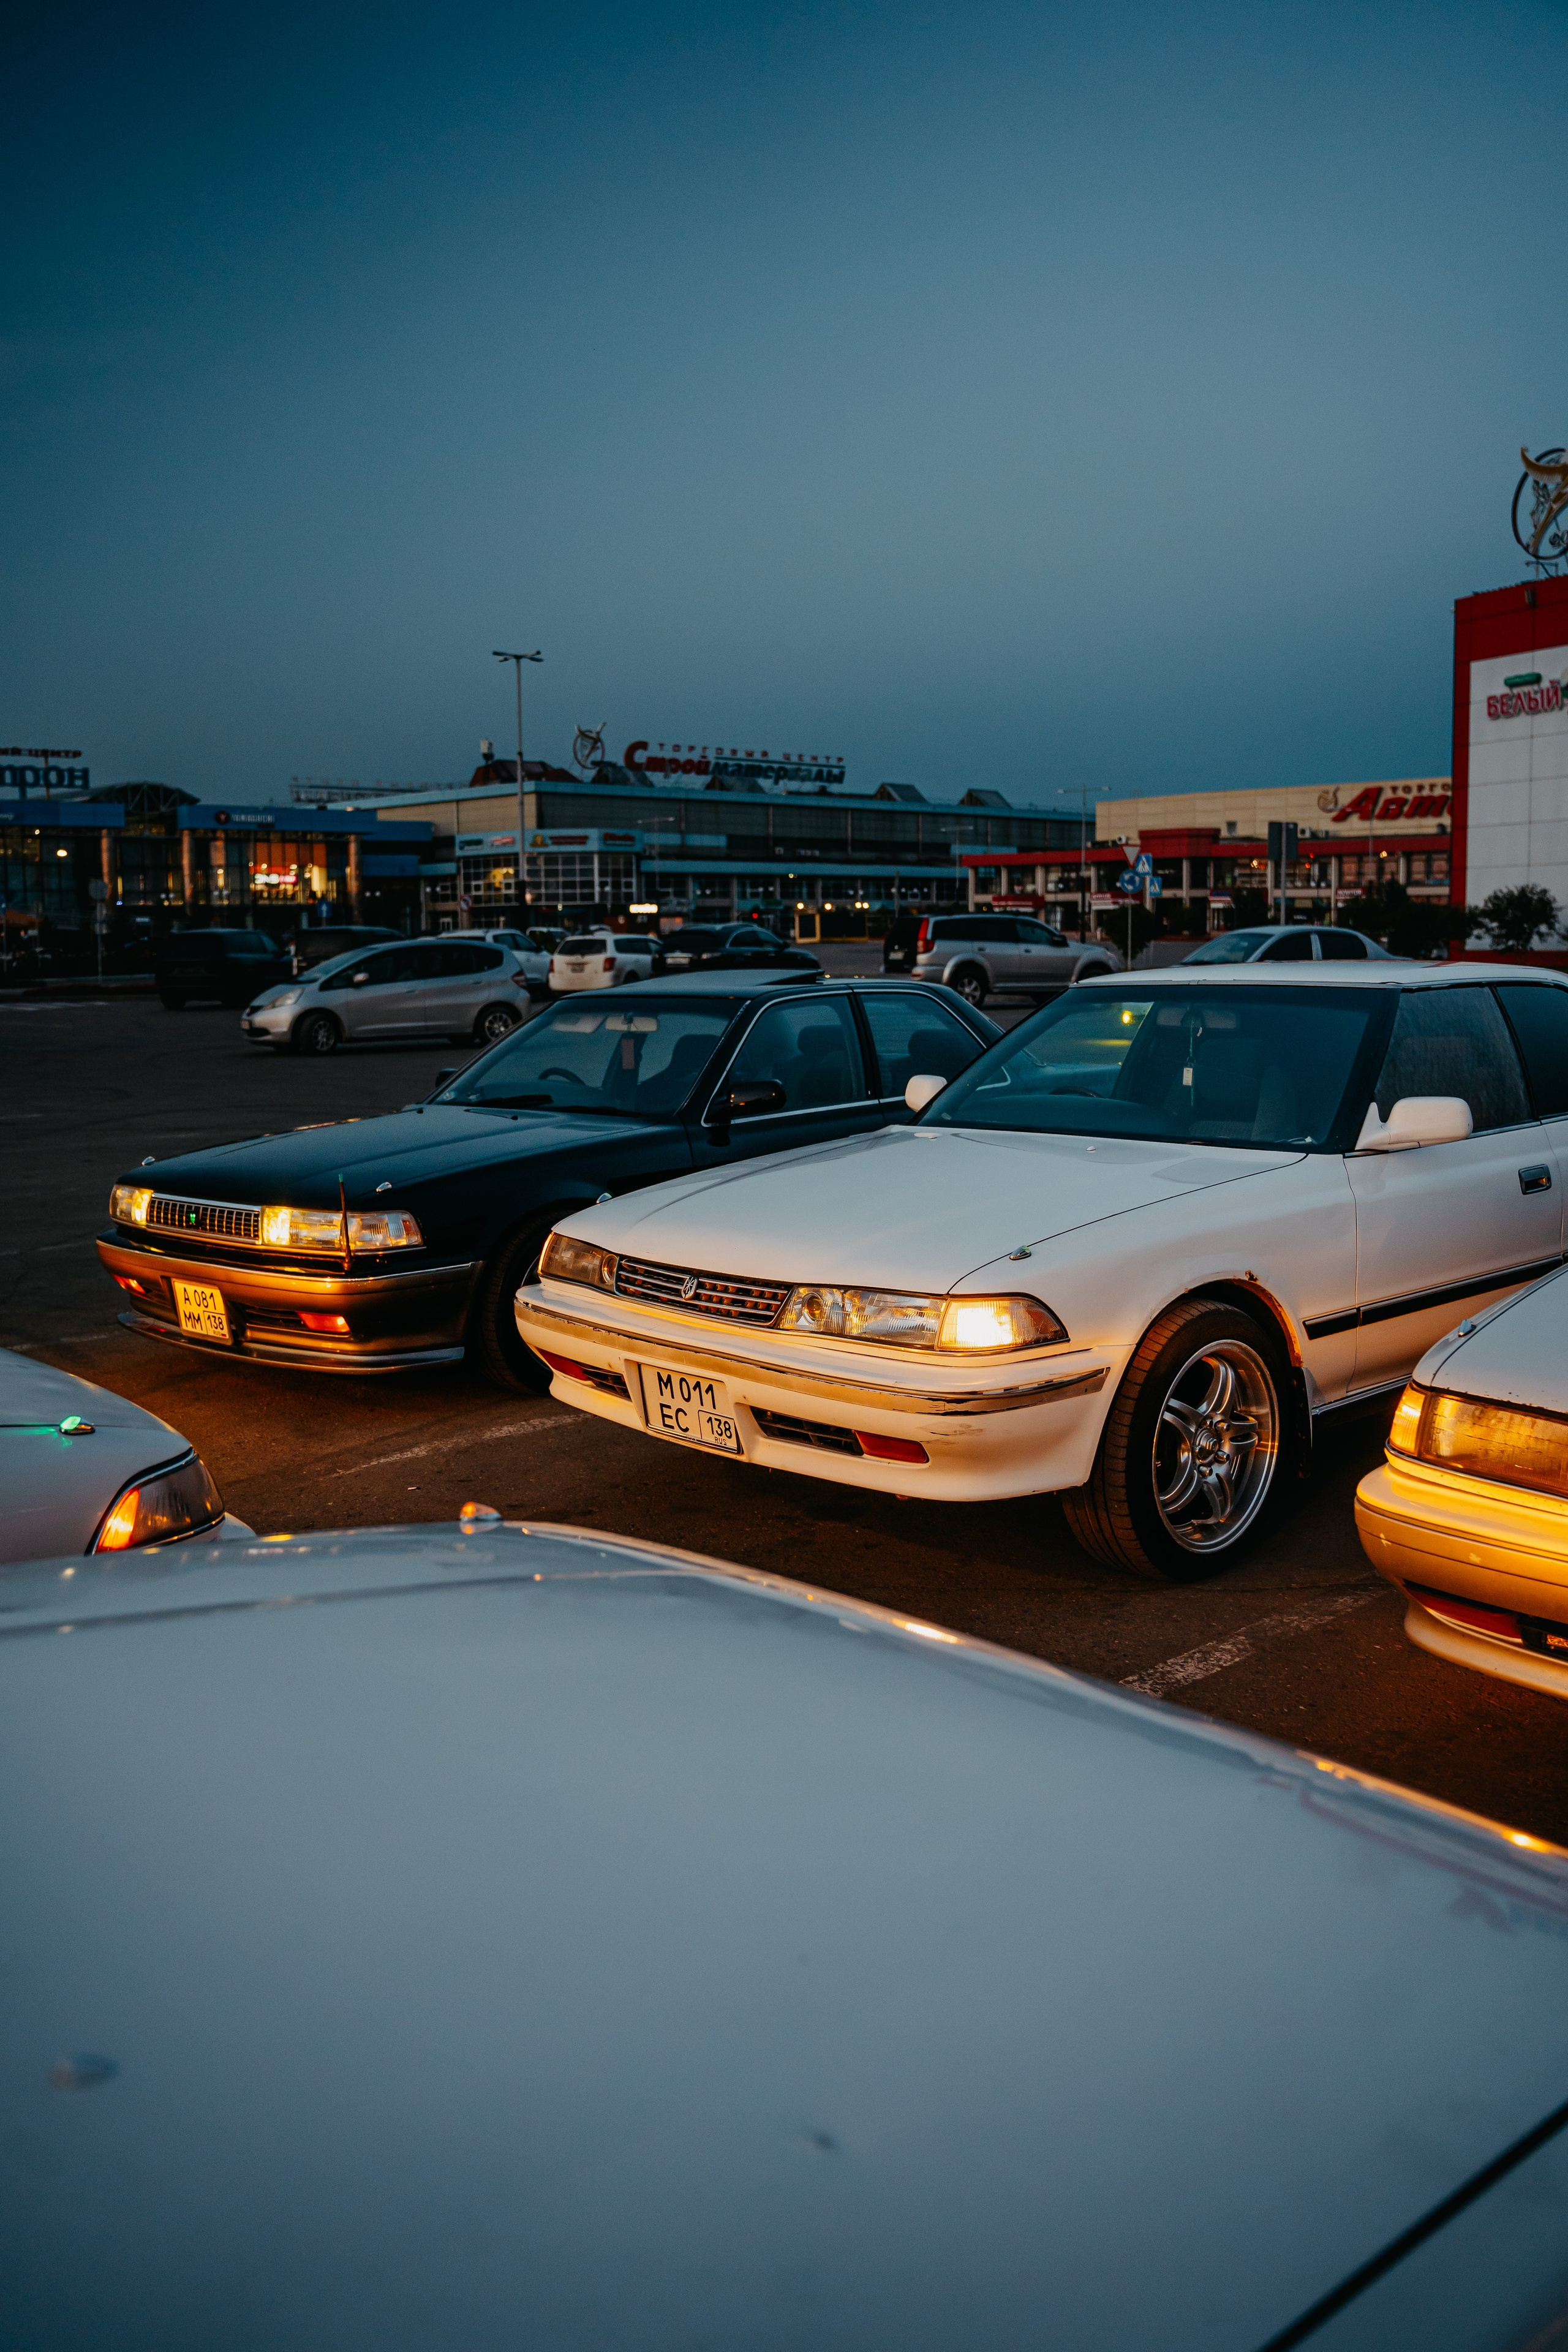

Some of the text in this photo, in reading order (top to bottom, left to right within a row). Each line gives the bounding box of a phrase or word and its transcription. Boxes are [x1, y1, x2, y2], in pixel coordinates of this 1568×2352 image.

[1487, 679, 1561, 718] БЕЛЫЙ
[783, 753, 844, 764] ЦЕНТР
[1331, 786, 1452, 822] Авт
[183, 1310, 203, 1331] ММ
[206, 1314, 224, 1330] 138
[659, 1402, 690, 1433] ЕС
[706, 1416, 733, 1439] 138
[714, 1436, 727, 1446] RUS
